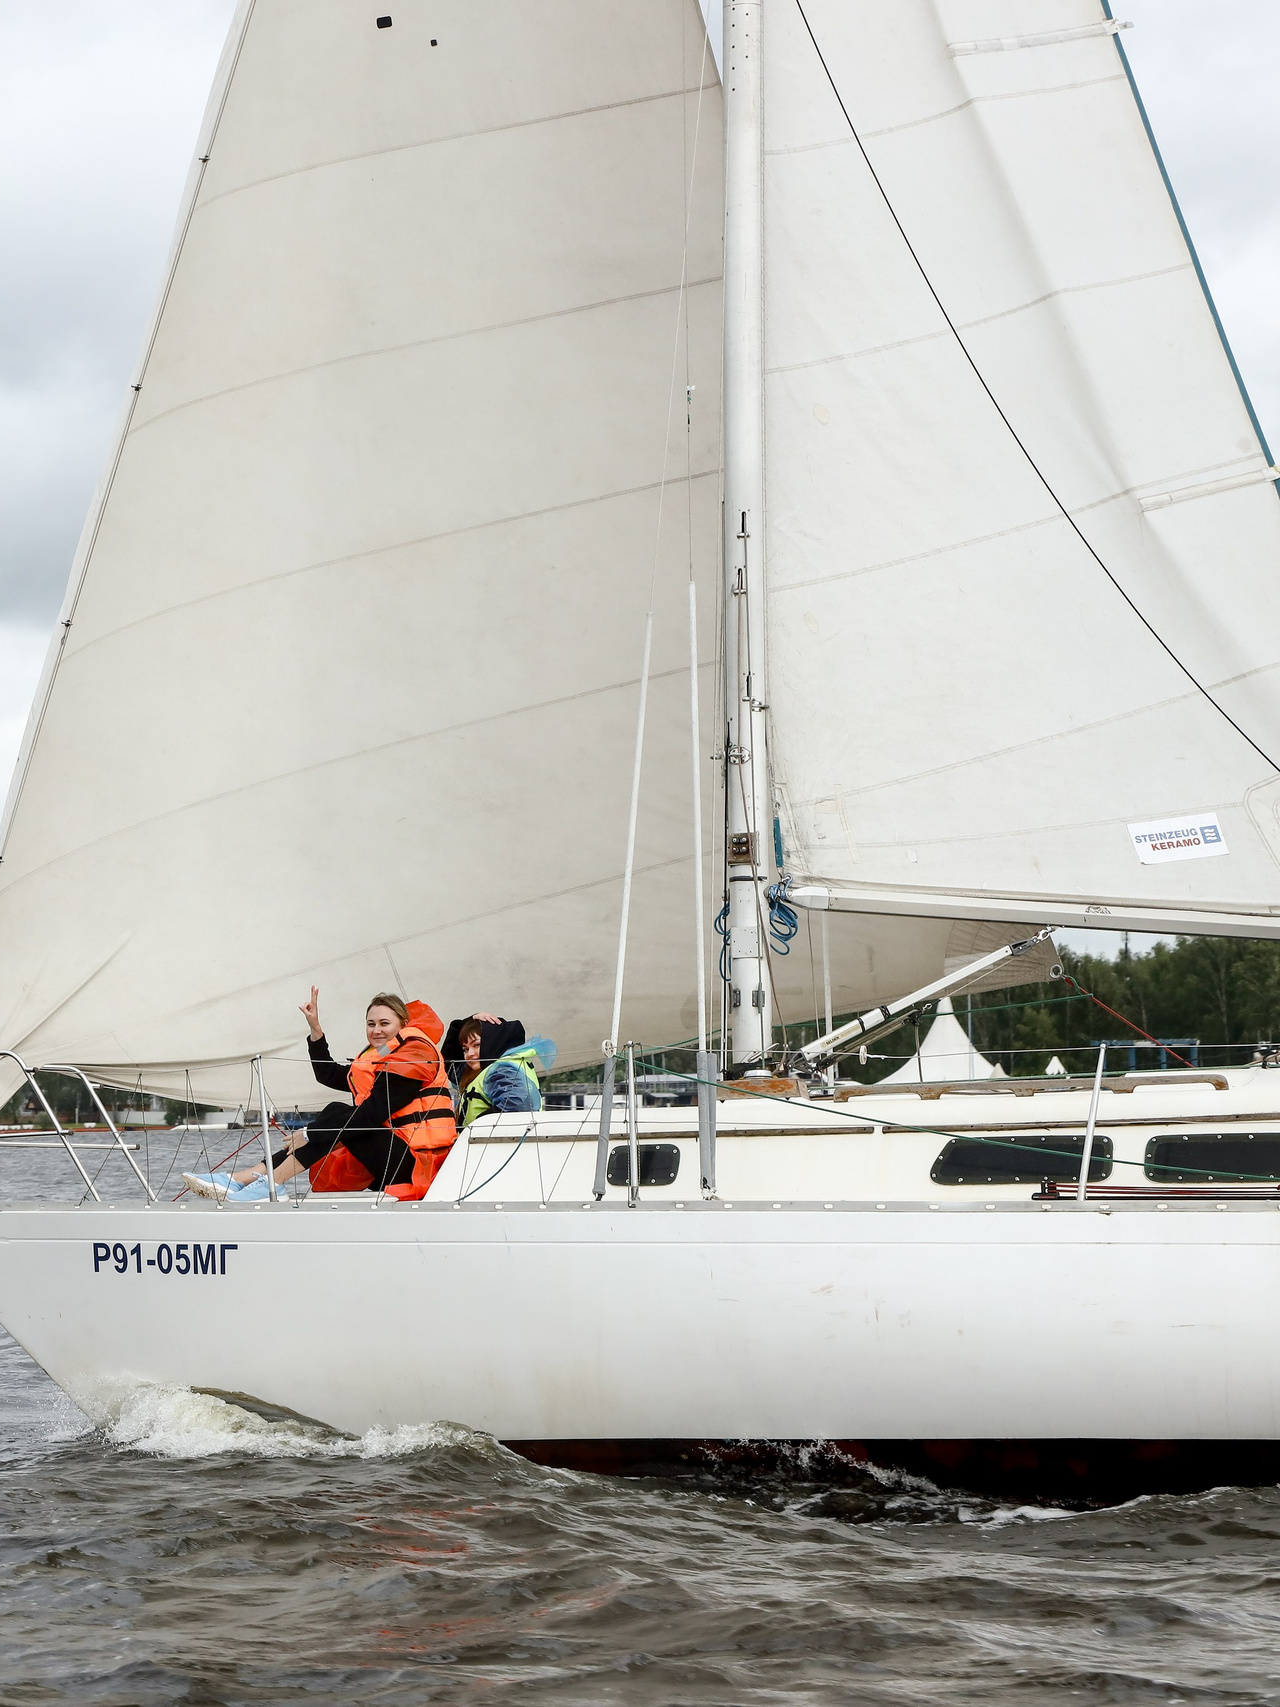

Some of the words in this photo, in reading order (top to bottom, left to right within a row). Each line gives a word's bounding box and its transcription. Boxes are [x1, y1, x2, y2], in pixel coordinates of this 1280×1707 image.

[1135, 828, 1198, 844] STEINZEUG
[1151, 837, 1201, 851] KERAMO
[92, 1242, 238, 1275] Р91-05МГ
